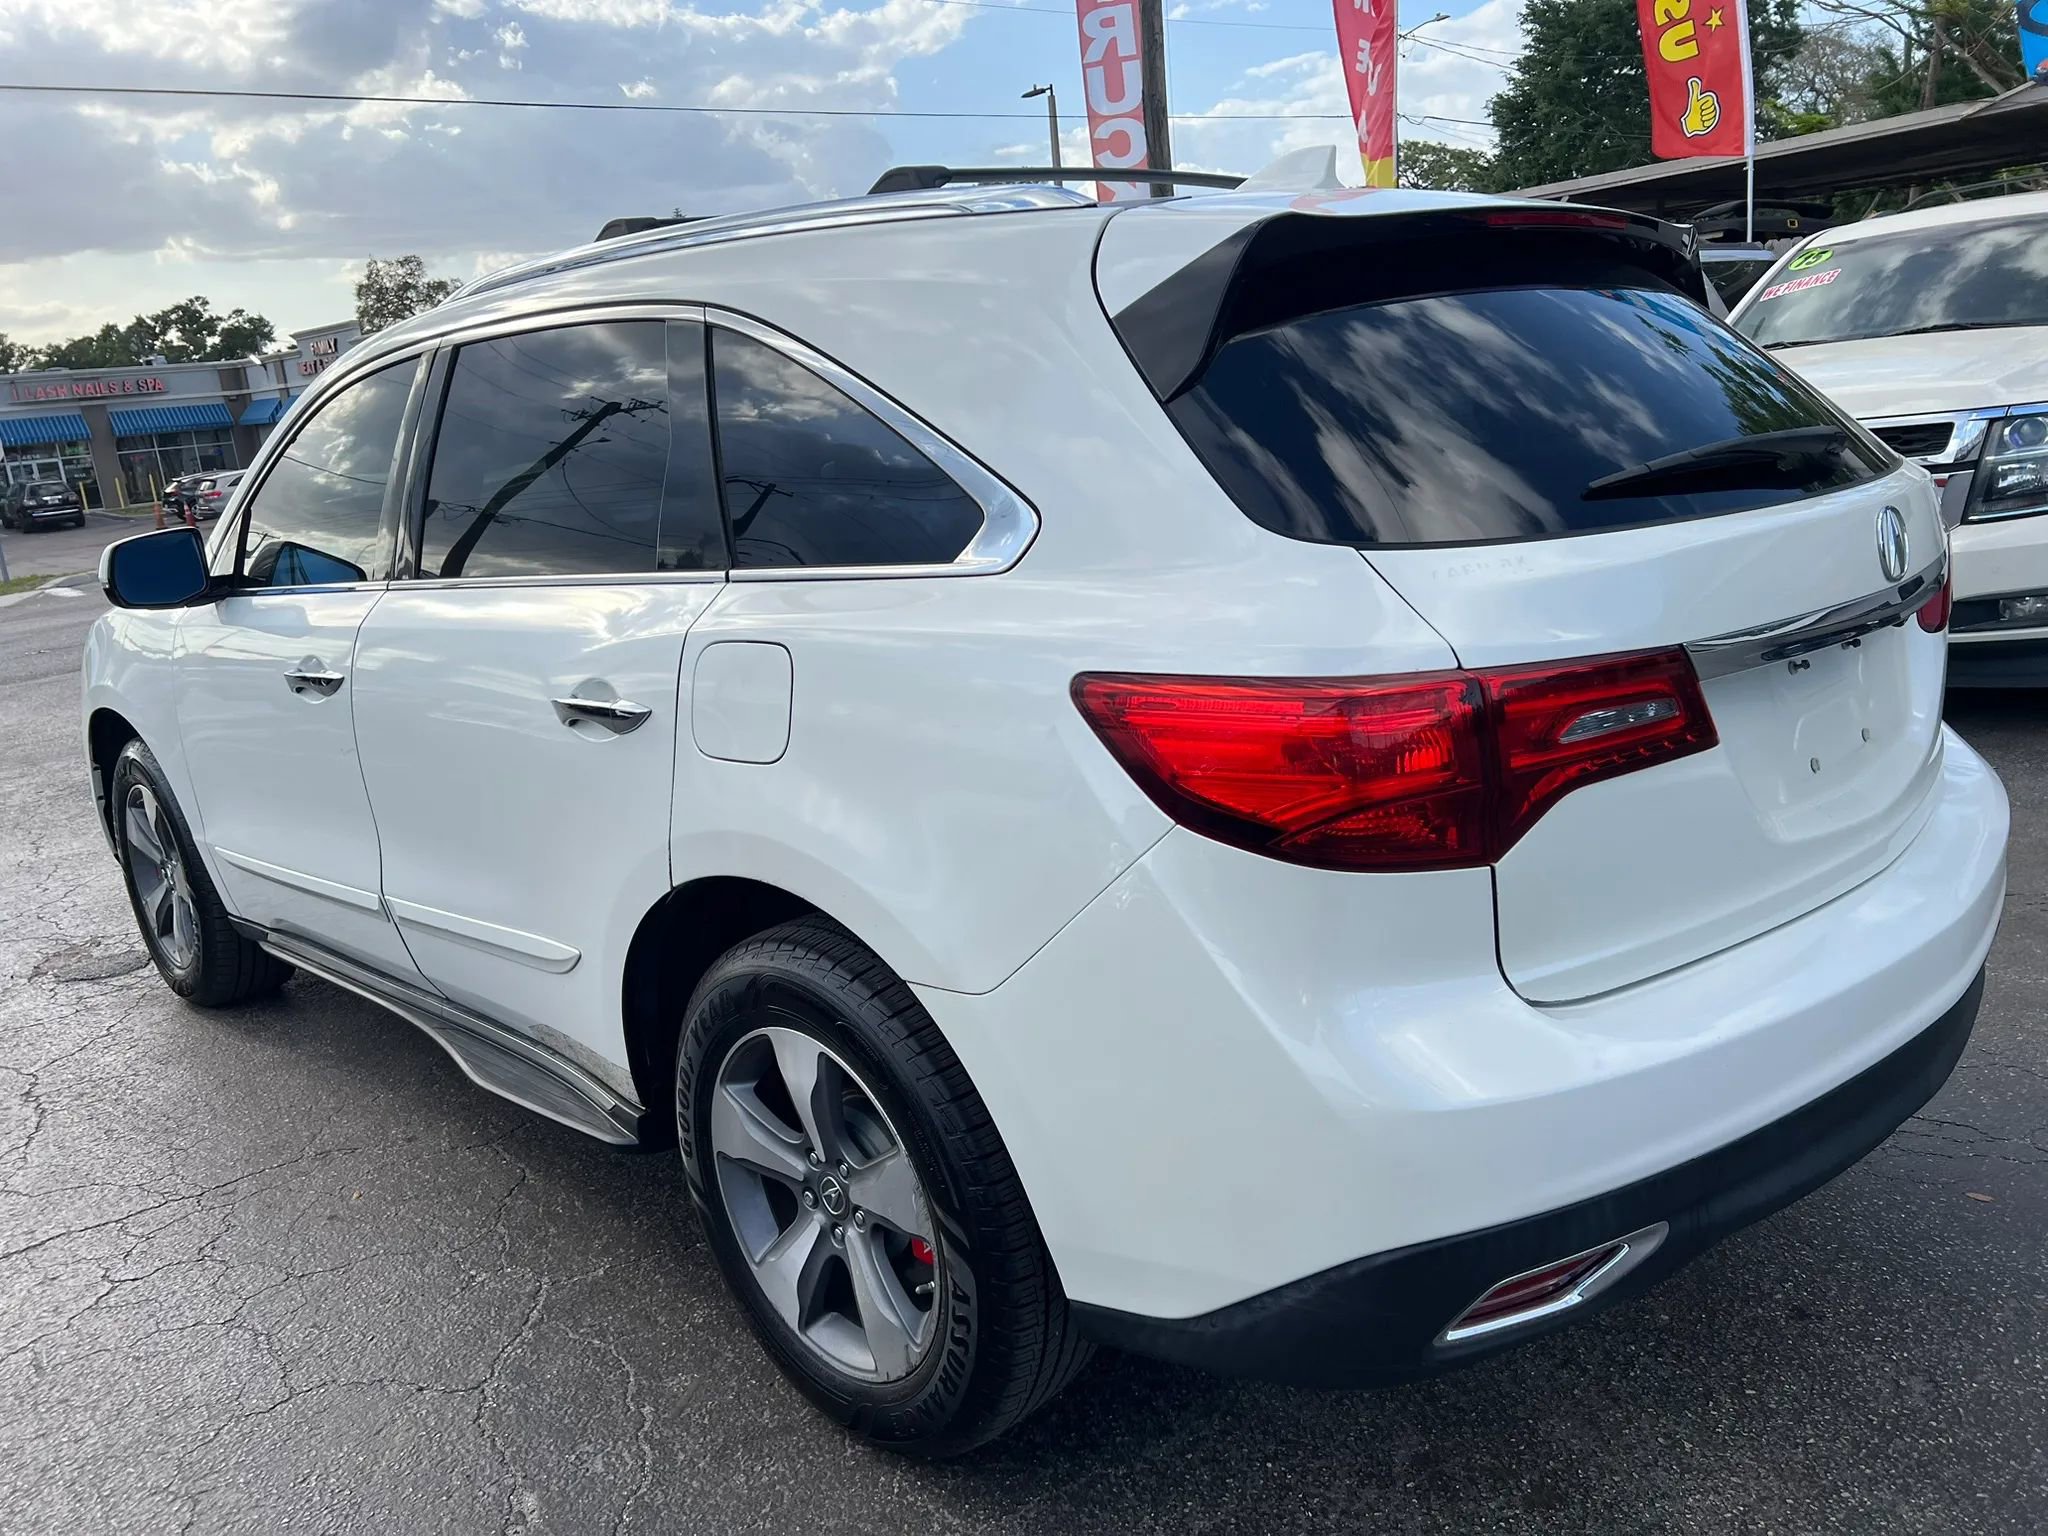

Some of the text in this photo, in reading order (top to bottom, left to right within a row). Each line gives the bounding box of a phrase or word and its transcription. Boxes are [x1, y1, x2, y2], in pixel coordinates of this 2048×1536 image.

[1763, 270, 1840, 299] WE FINANCE
[310, 337, 336, 354] FAMILY
[24, 383, 67, 400] LASH
[72, 381, 118, 396] NAILS
[123, 379, 133, 393] &
[138, 378, 165, 392] SPA
